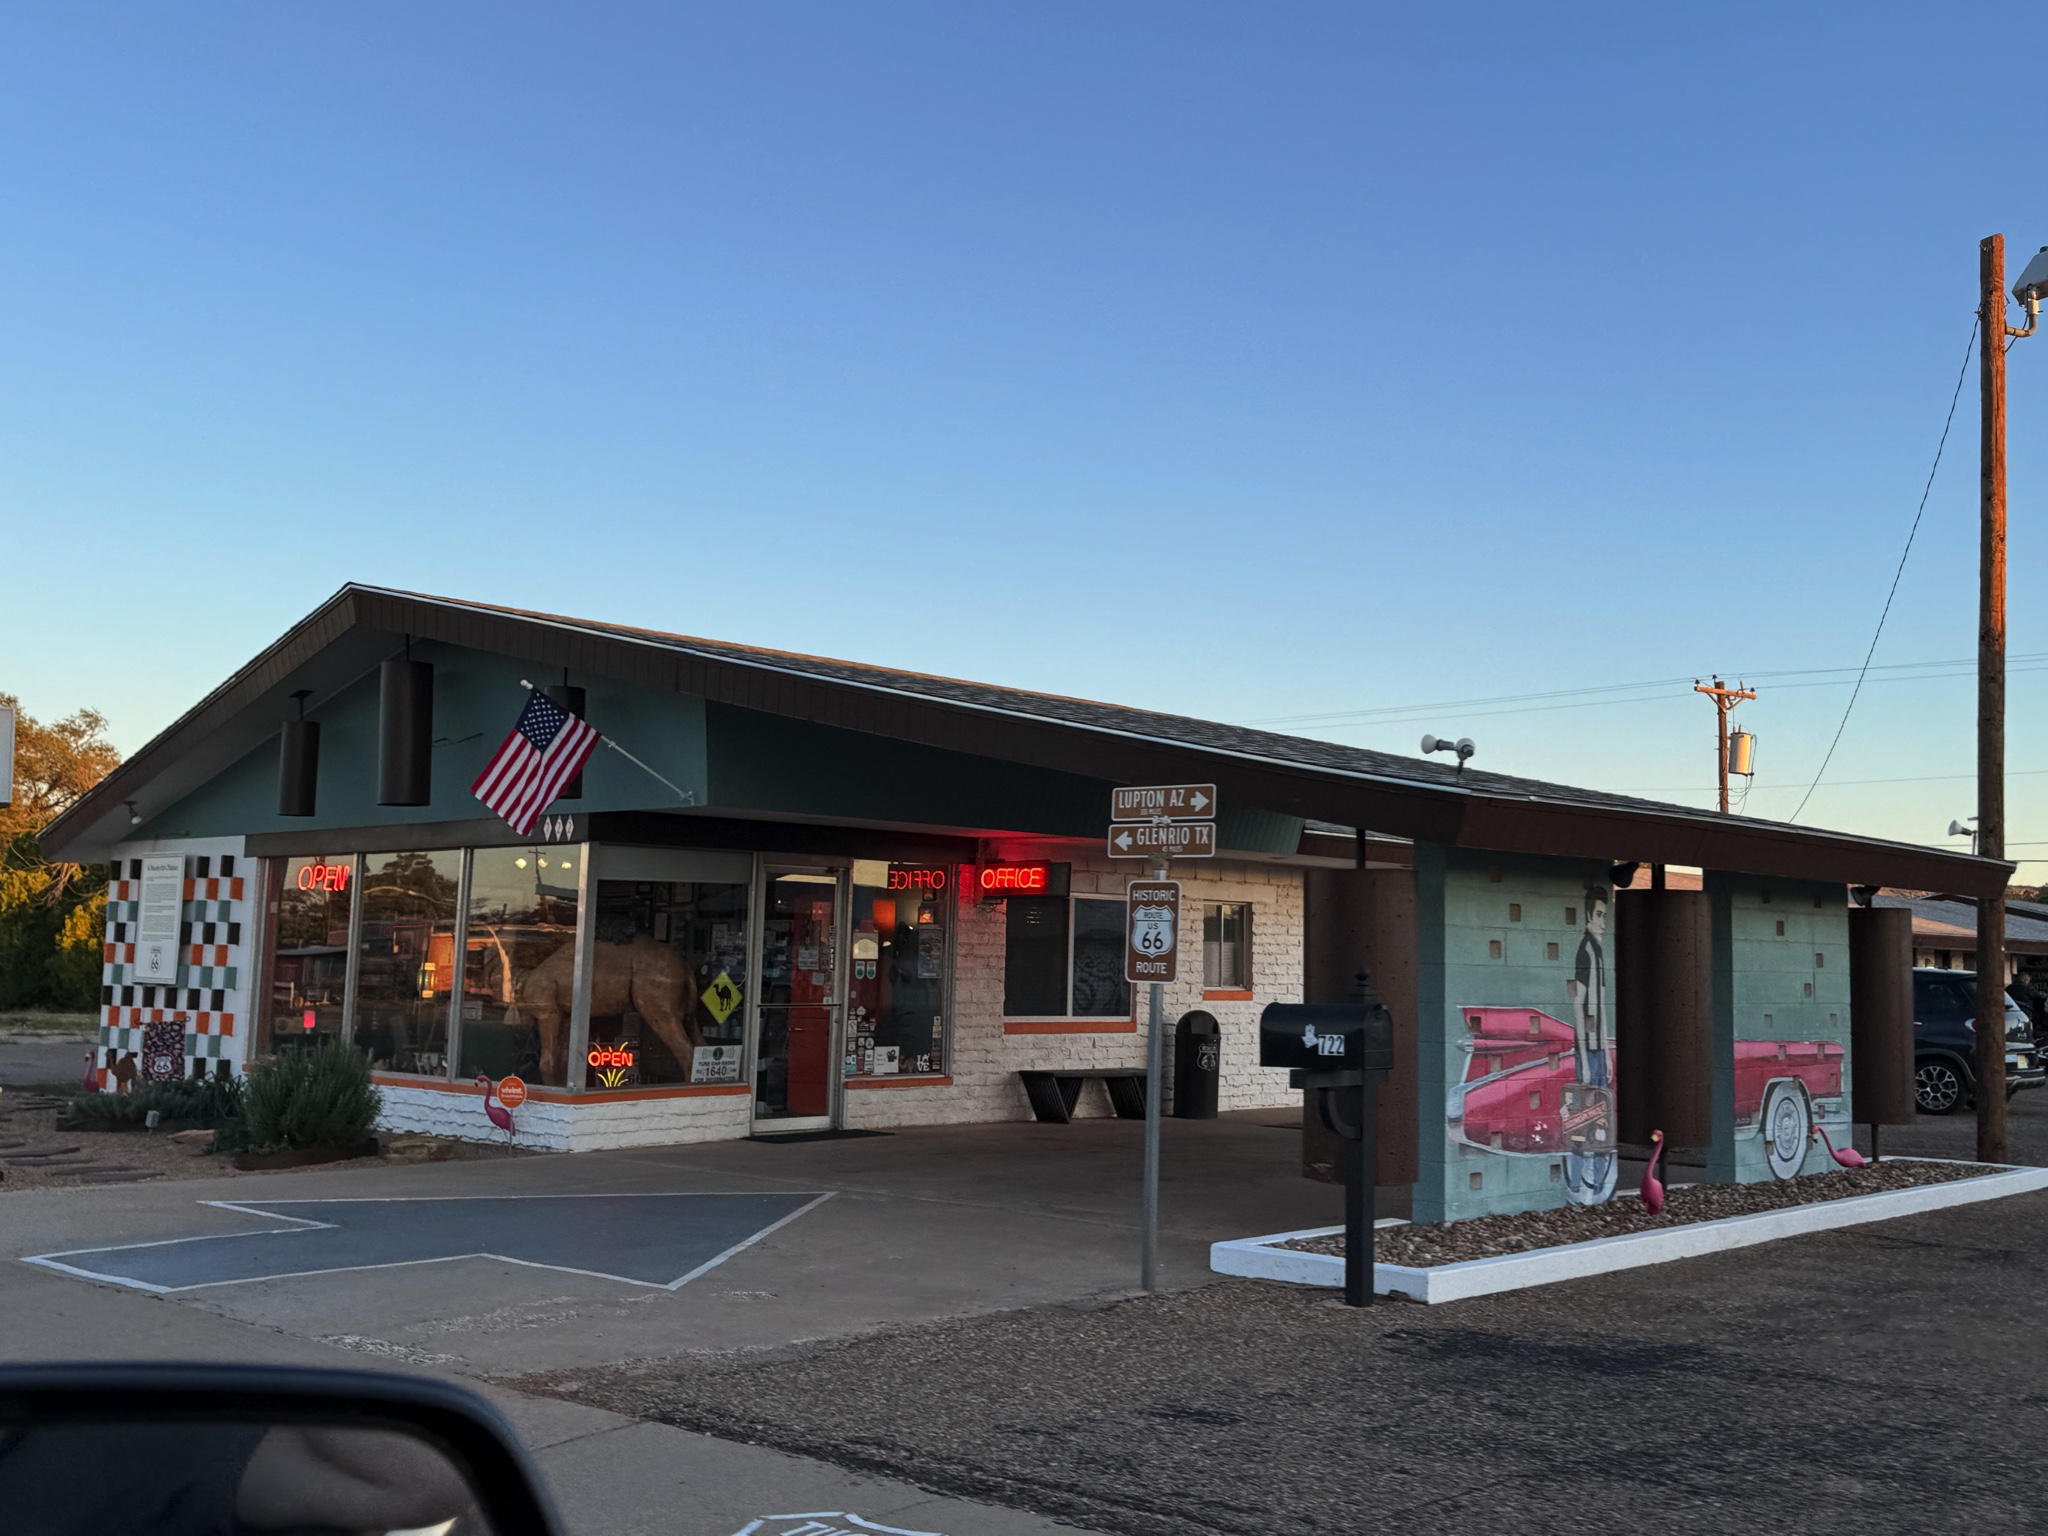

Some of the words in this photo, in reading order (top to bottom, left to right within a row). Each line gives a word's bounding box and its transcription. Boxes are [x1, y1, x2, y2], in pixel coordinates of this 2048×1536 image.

[1118, 790, 1165, 808] LUPTON
[1169, 789, 1185, 807] AZ
[1137, 827, 1190, 845] GLENRIO
[1195, 826, 1209, 844] TX
[298, 864, 350, 891] OPEN
[981, 867, 1044, 888] OFFICE
[1132, 889, 1176, 901] HISTORIC
[1143, 911, 1164, 919] ROUTE
[1147, 922, 1159, 930] US
[1142, 931, 1163, 950] 66
[1136, 961, 1168, 974] ROUTE
[1319, 1035, 1344, 1054] 722
[588, 1051, 633, 1067] OPEN
[706, 1066, 727, 1077] 1640
